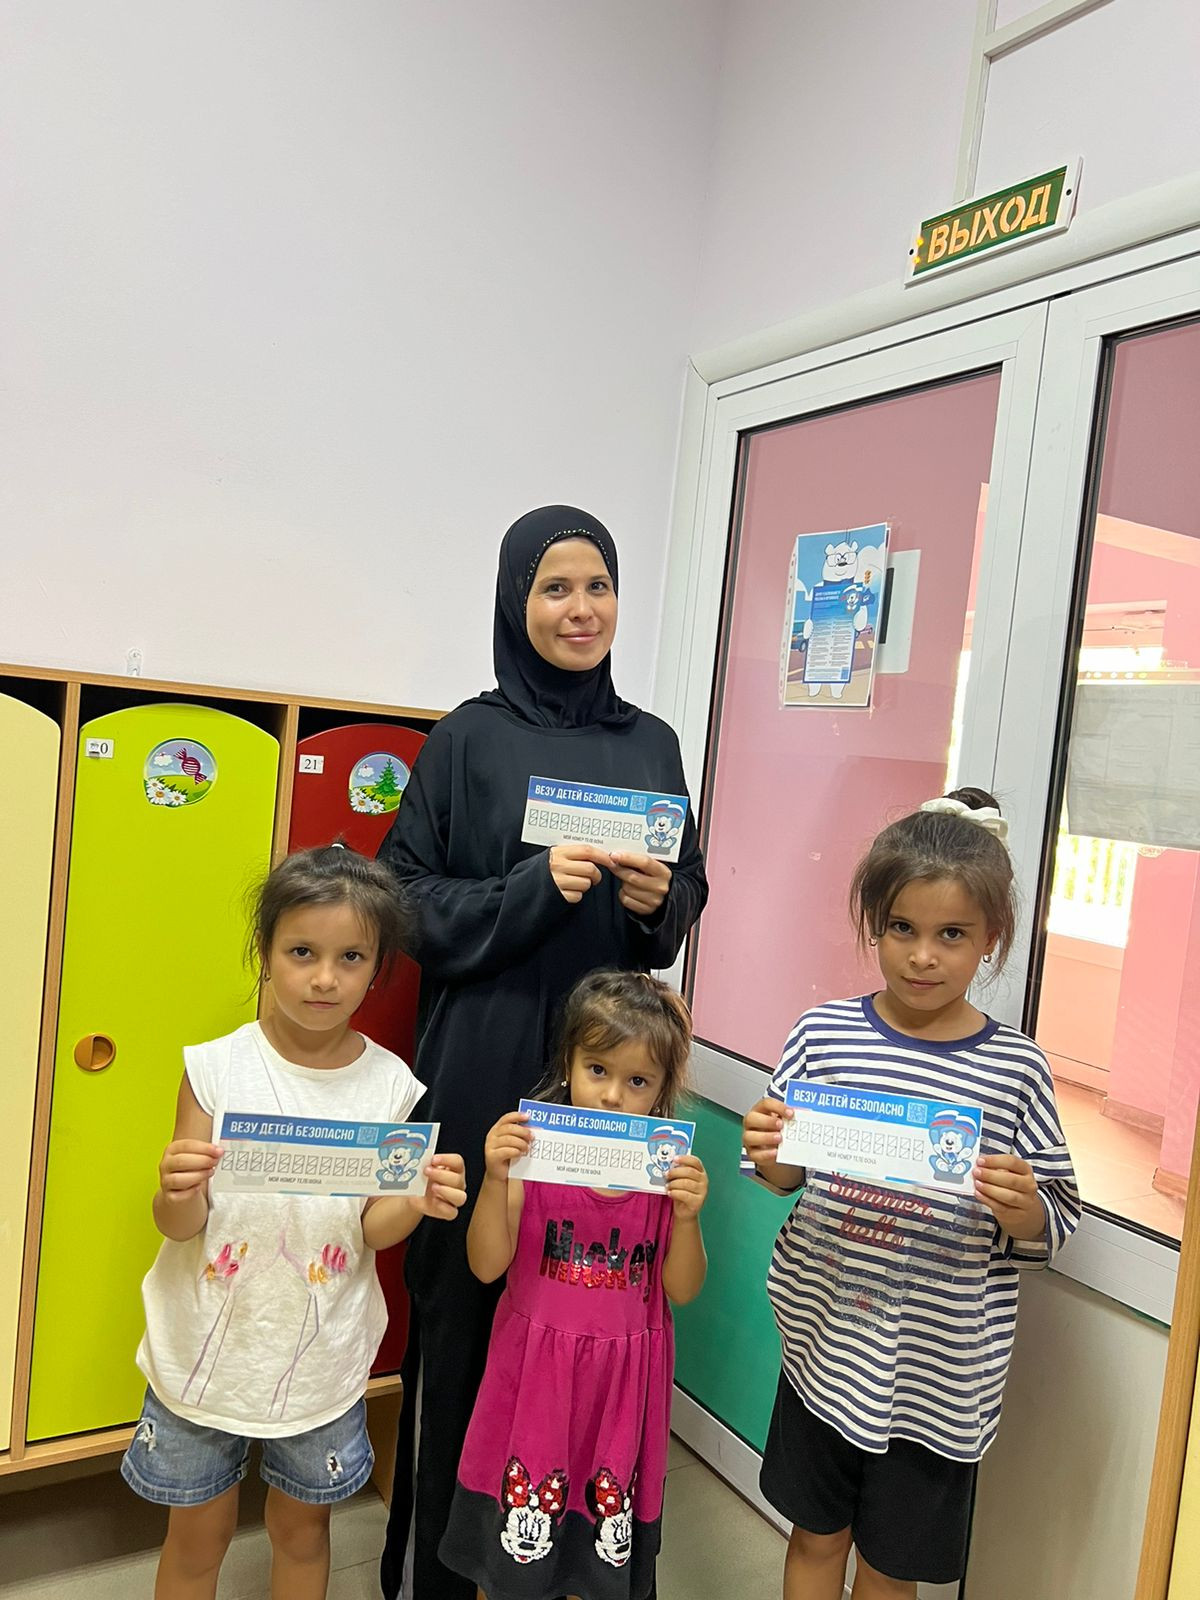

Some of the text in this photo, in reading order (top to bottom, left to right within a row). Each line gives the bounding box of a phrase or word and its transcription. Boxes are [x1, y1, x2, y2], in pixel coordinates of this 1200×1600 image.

[927, 184, 1052, 263] ВЫХОД
[304, 758, 317, 770] 21
[535, 784, 629, 807] ВЕЗУ ДЕТЕЙ БЕЗОПАСНО
[793, 1089, 904, 1117] ВЕЗУ ДЕТЕЙ БЕЗОПАСНО
[230, 1121, 355, 1141] ВЕЗУ ДЕТЕЙ БЕЗОПАСНО
[548, 1112, 577, 1127] ДЕТЕЙ
[578, 1116, 627, 1133] БЕЗОПАСНО
[840, 1207, 905, 1249] hello
